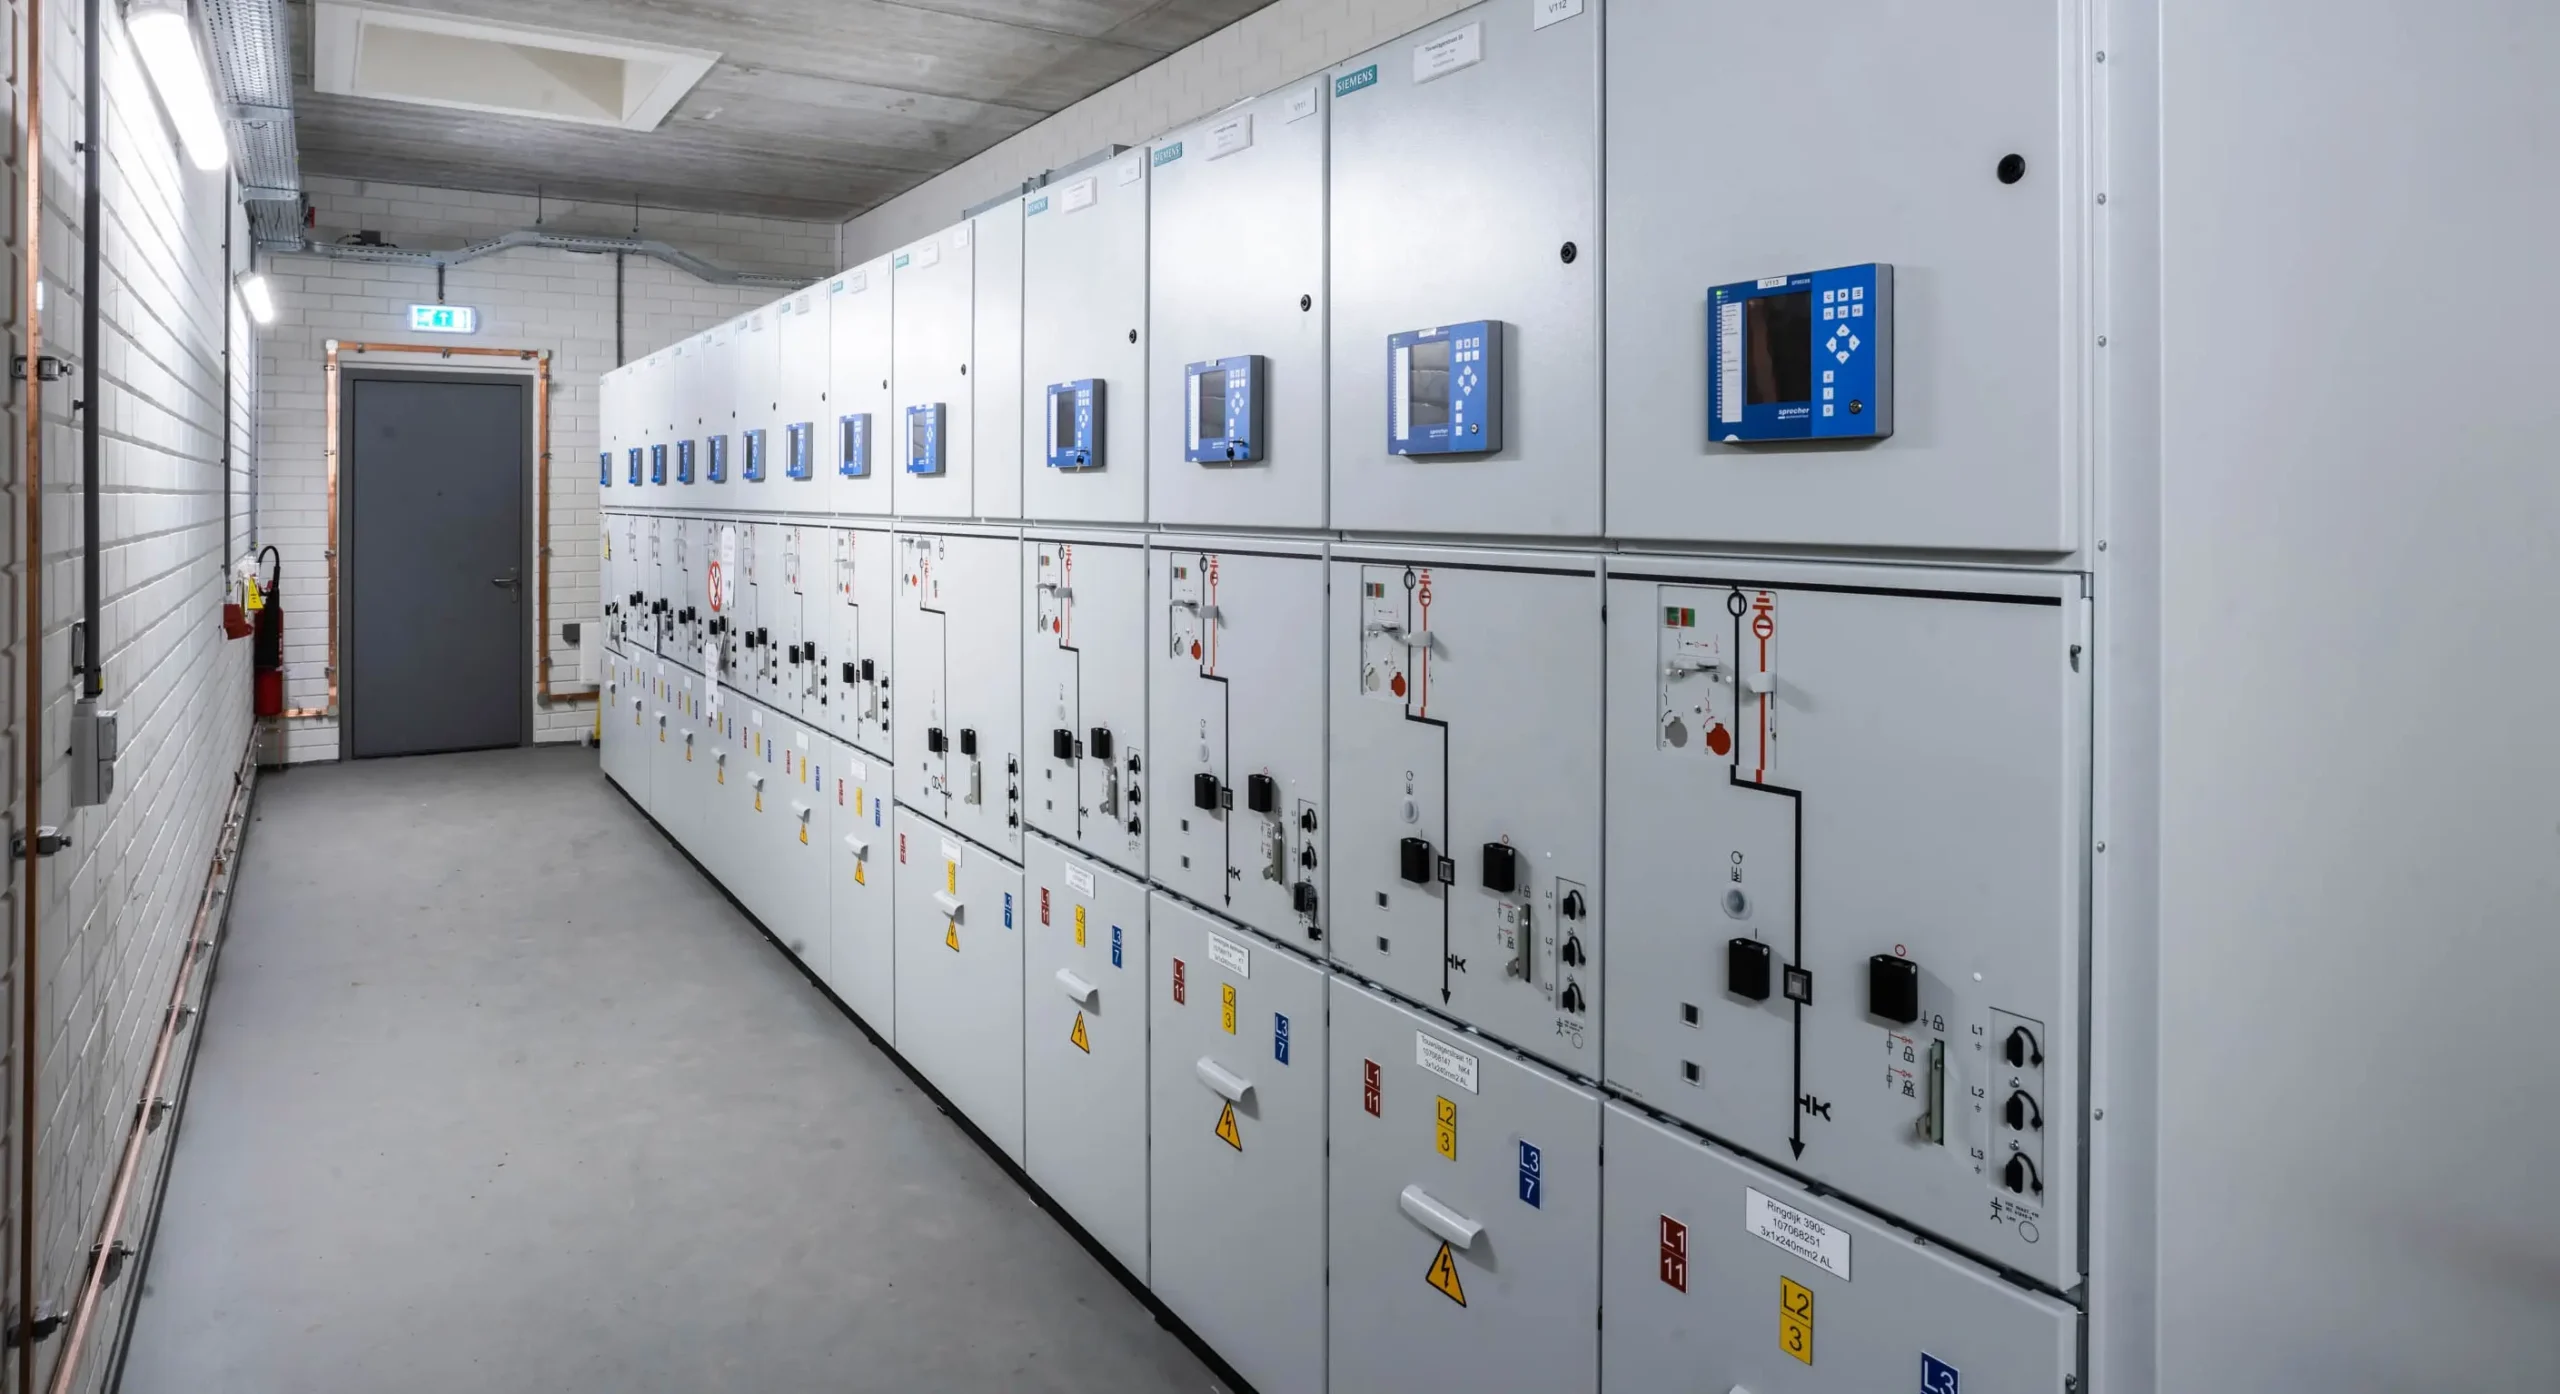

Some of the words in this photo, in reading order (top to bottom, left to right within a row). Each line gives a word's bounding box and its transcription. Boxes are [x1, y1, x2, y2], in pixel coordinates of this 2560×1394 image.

[1549, 0, 1567, 13] V112
[1337, 69, 1374, 92] SIEMENS
[1778, 407, 1810, 417] sprecher
[1174, 961, 1184, 980] L1
[1174, 984, 1184, 1001] 11
[1223, 987, 1234, 1007] L2
[1225, 1012, 1232, 1028] 3
[1275, 1016, 1288, 1037] L3
[1971, 1023, 1983, 1036] L1
[1278, 1042, 1285, 1058] 7
[1365, 1062, 1380, 1087] L1
[1366, 1091, 1380, 1113] 11
[1971, 1085, 1985, 1098] L2
[1437, 1101, 1454, 1127] L2
[1441, 1132, 1450, 1152] 3
[1521, 1146, 1539, 1173] L3
[1971, 1147, 1984, 1160] L3
[1524, 1179, 1535, 1199] 7
[1766, 1200, 1802, 1224] Ringdijk
[1803, 1217, 1826, 1236] 390c
[1663, 1221, 1685, 1253] L1
[1773, 1218, 1820, 1248] 107068251
[1760, 1225, 1818, 1262] 3x1x240mm2
[1820, 1255, 1833, 1269] AL
[1664, 1257, 1683, 1286] 11
[1783, 1284, 1809, 1320] L2
[1789, 1325, 1803, 1352] 3
[1924, 1360, 1955, 1394] L3
